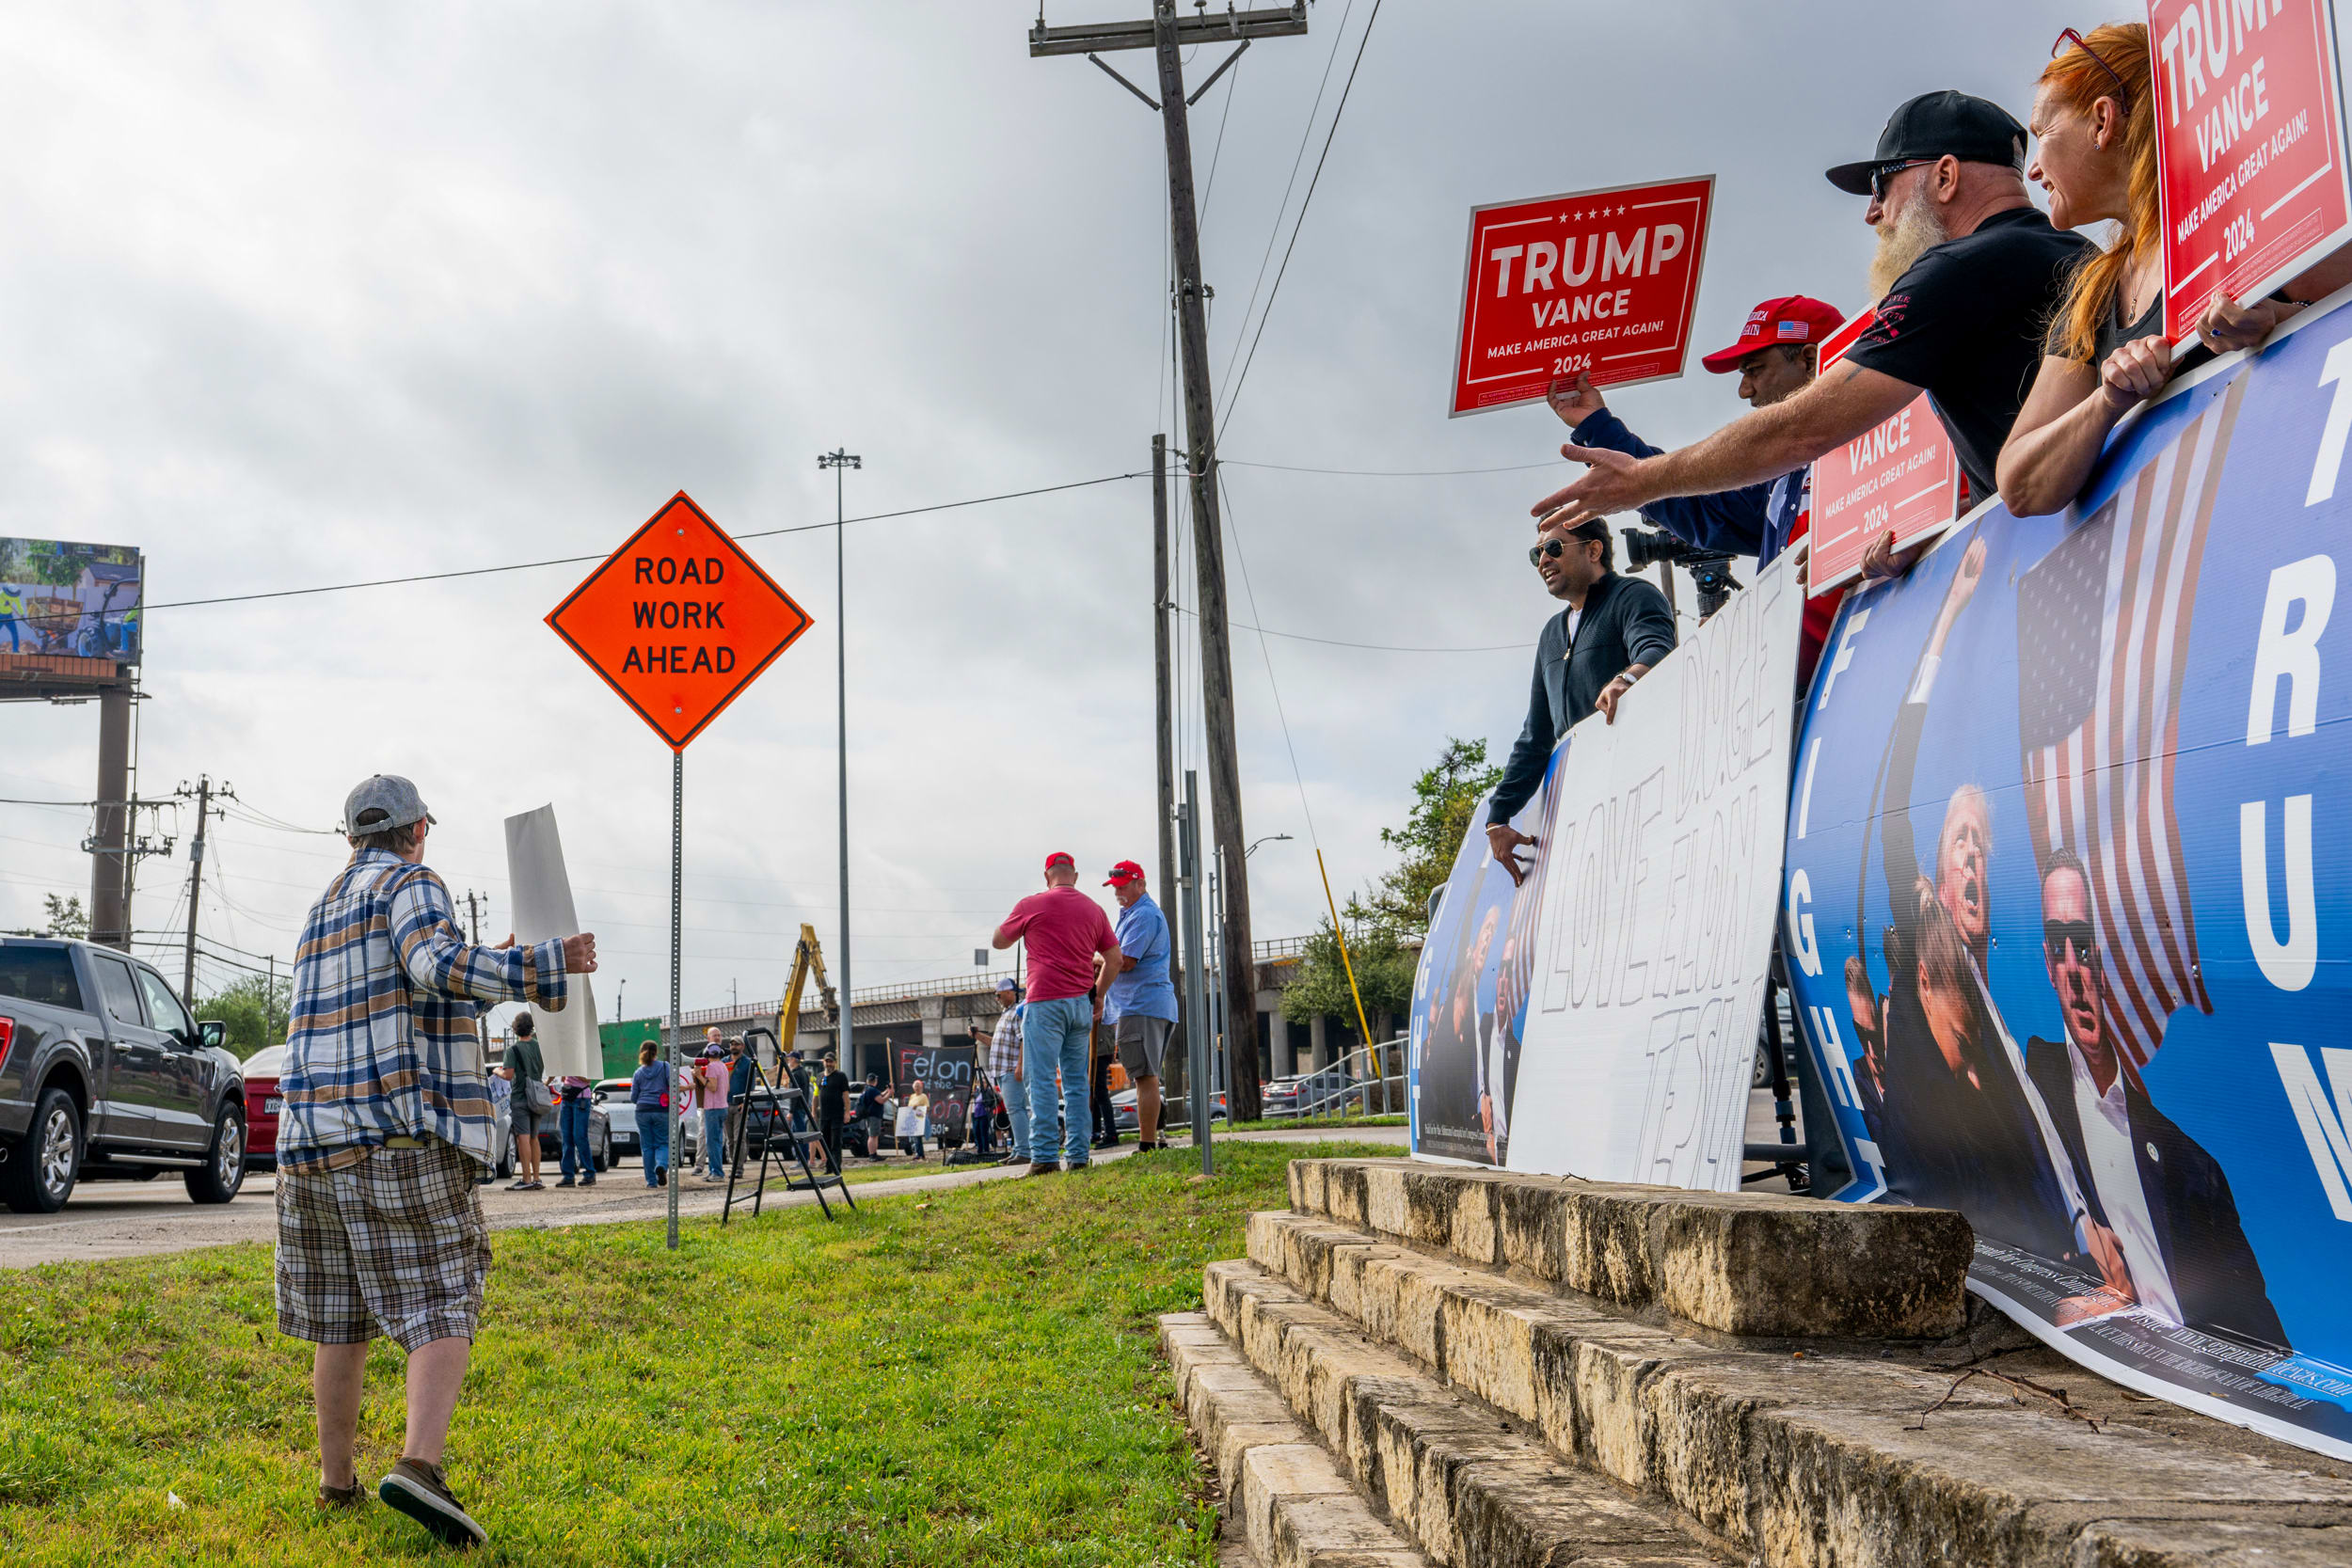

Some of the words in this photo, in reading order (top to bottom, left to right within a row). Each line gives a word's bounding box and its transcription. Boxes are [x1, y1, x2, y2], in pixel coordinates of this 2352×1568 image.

[2161, 0, 2282, 129] TRUM
[2196, 55, 2269, 174] VANCE
[2177, 206, 2200, 245] MAKE
[2201, 173, 2237, 226] AMERICA
[2238, 141, 2269, 188] GREAT
[2271, 108, 2309, 161] AGAIN!
[1490, 223, 1685, 298] TRUMP
[2223, 208, 2255, 264] 2024
[1532, 288, 1631, 329] VANCE
[1486, 342, 1522, 359] MAKE
[1524, 333, 1579, 354] AMERICA
[1581, 326, 1620, 343] GREAT
[1622, 320, 1664, 337] AGAIN!
[1552, 353, 1592, 375] 2024
[1849, 408, 1912, 476] VANCE
[1824, 496, 1845, 519] MAKE
[1845, 480, 1879, 508] AMERICA
[1880, 461, 1905, 487] GREAT
[1906, 443, 1937, 474] AGAIN!
[1863, 500, 1889, 535] 2024
[635, 557, 724, 585] ROAD
[633, 601, 725, 629] WORK
[622, 646, 736, 673] AHEAD
[1541, 765, 1665, 1014] LOVE
[1651, 784, 1758, 999] ELON
[1788, 606, 1888, 1191] FIGHT
[899, 1048, 971, 1083] Felon
